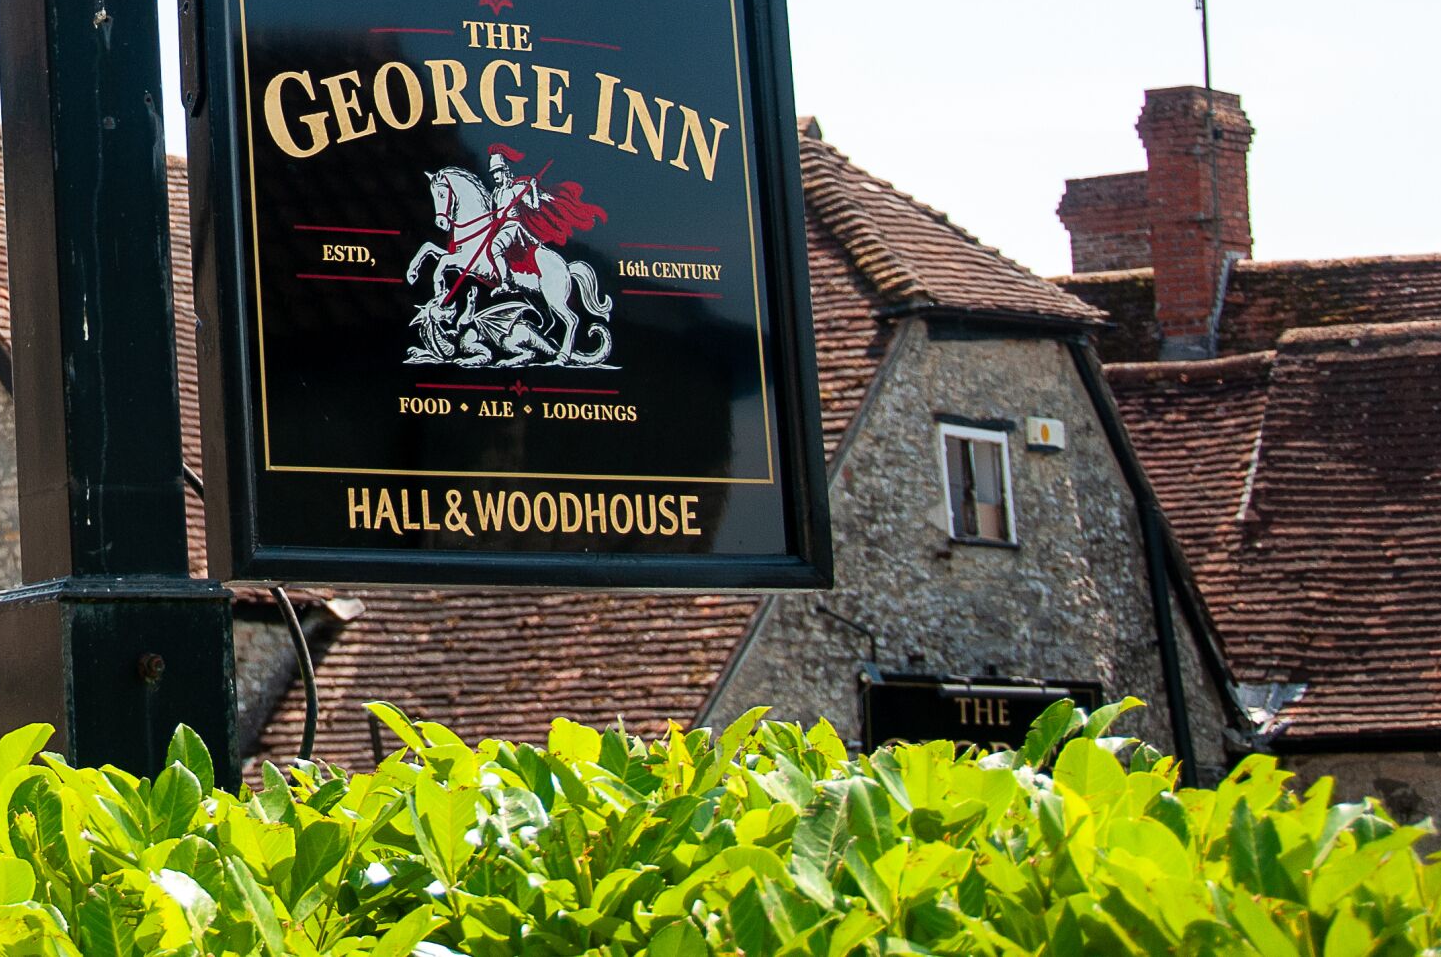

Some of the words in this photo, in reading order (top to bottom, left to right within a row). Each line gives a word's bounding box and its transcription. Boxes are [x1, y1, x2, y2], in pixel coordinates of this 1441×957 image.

[463, 20, 533, 52] THE
[263, 58, 574, 160] GEORGE
[588, 71, 729, 182] INN
[322, 244, 376, 267] ESTD,
[618, 260, 650, 277] 16th
[651, 261, 722, 281] CENTURY
[399, 397, 452, 415] FOOD
[478, 400, 514, 418] ALE
[542, 402, 637, 422] LODGINGS
[954, 696, 1011, 726] THE
